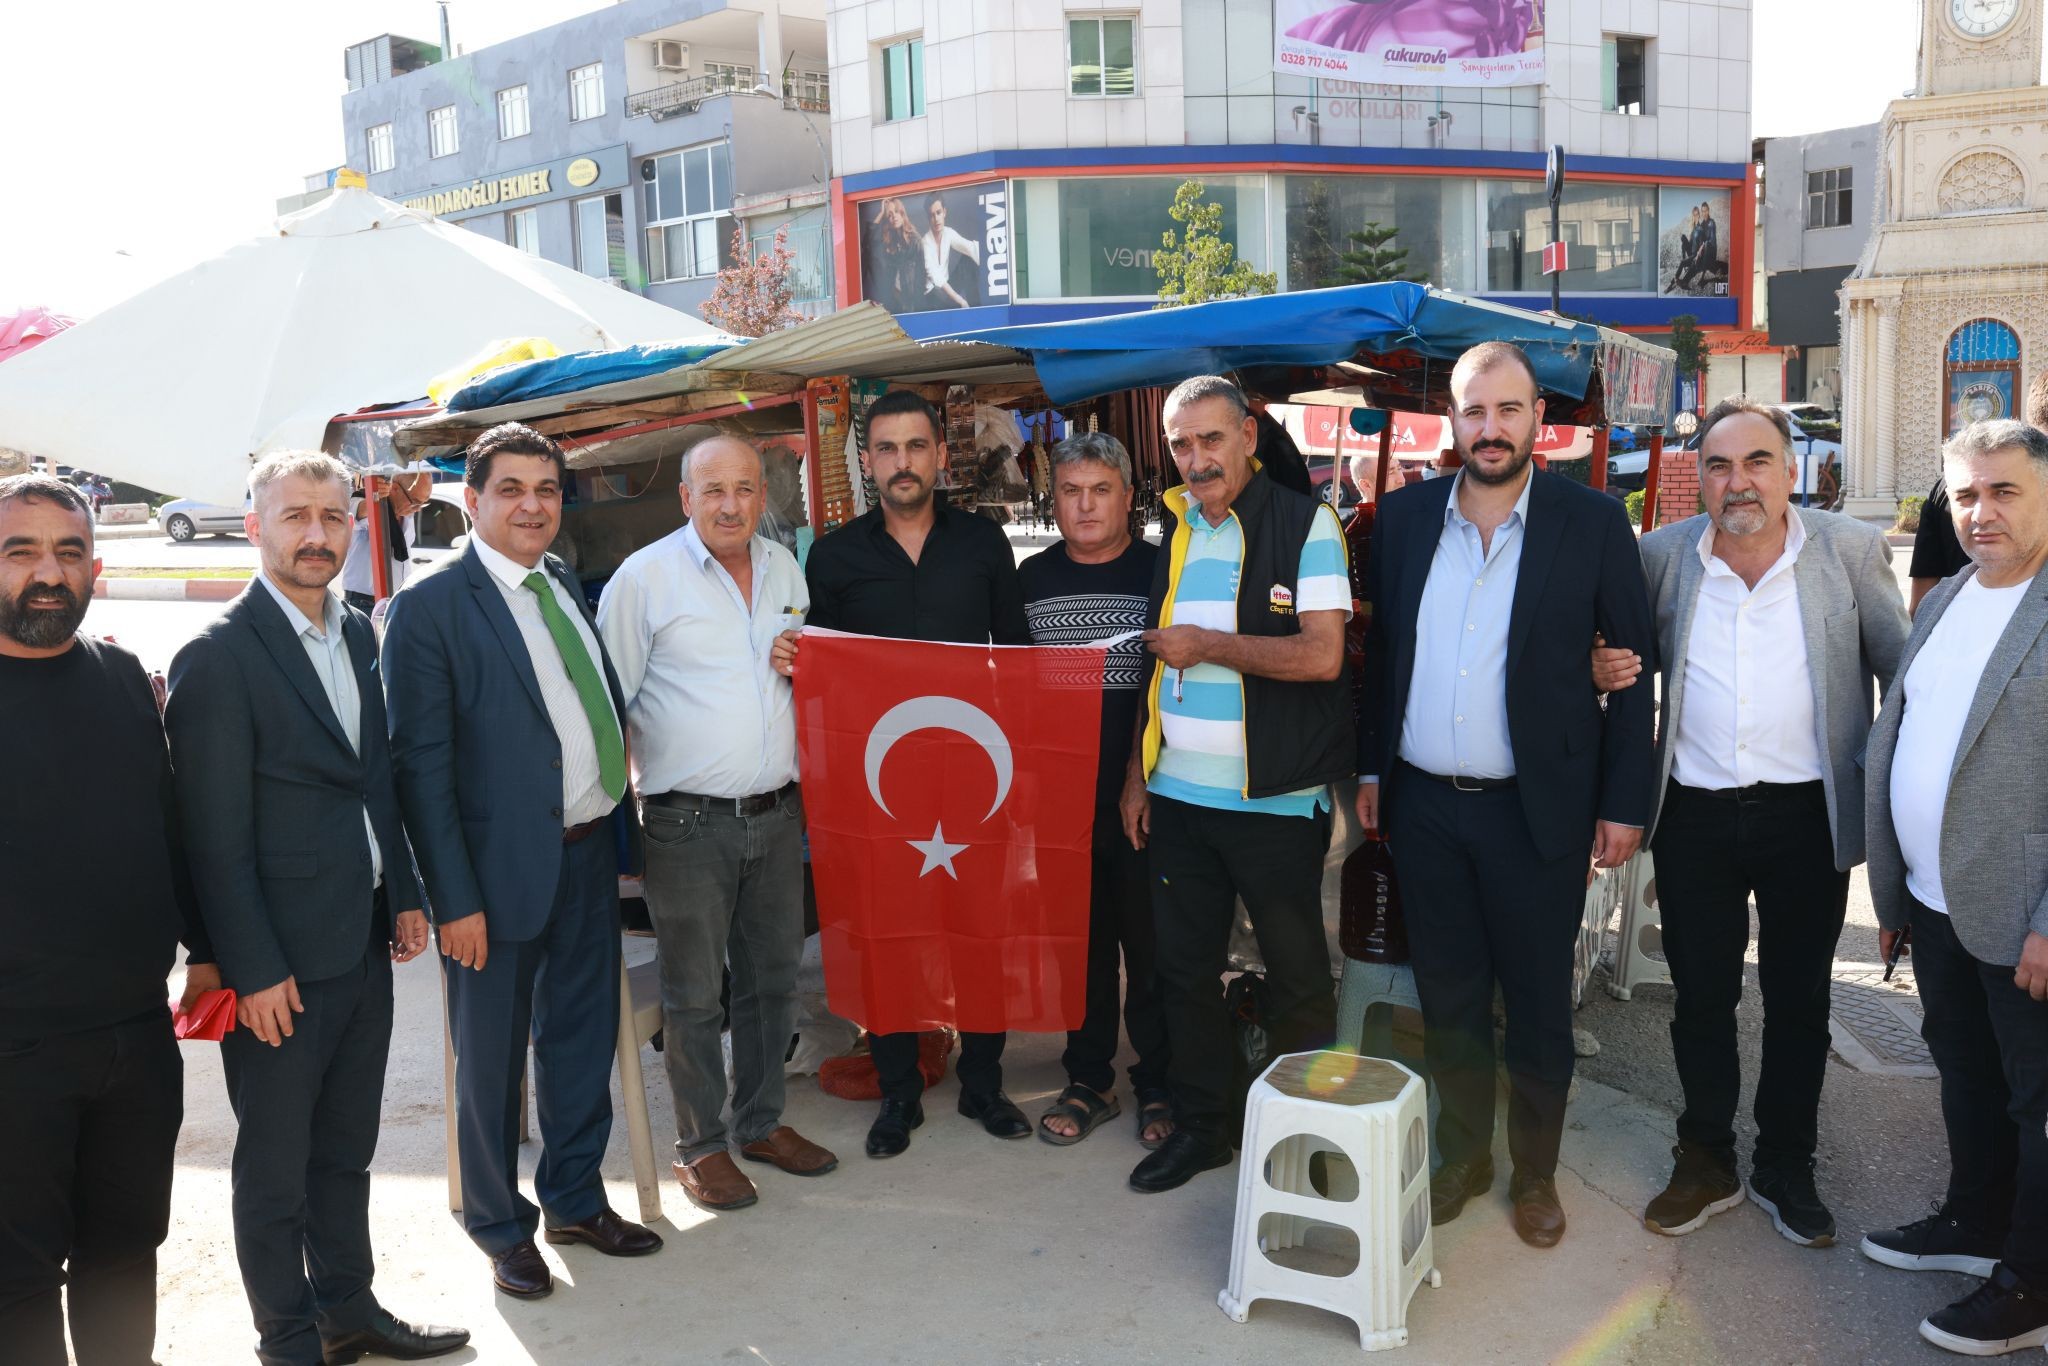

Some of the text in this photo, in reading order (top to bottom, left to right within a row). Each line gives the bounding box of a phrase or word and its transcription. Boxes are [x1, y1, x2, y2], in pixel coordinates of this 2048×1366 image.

[1281, 52, 1349, 72] 0328 717 4044
[1328, 99, 1422, 120] OKULLARI
[500, 169, 551, 201] EKMEK
[978, 191, 1009, 296] mavi
[1715, 282, 1729, 295] LOFT
